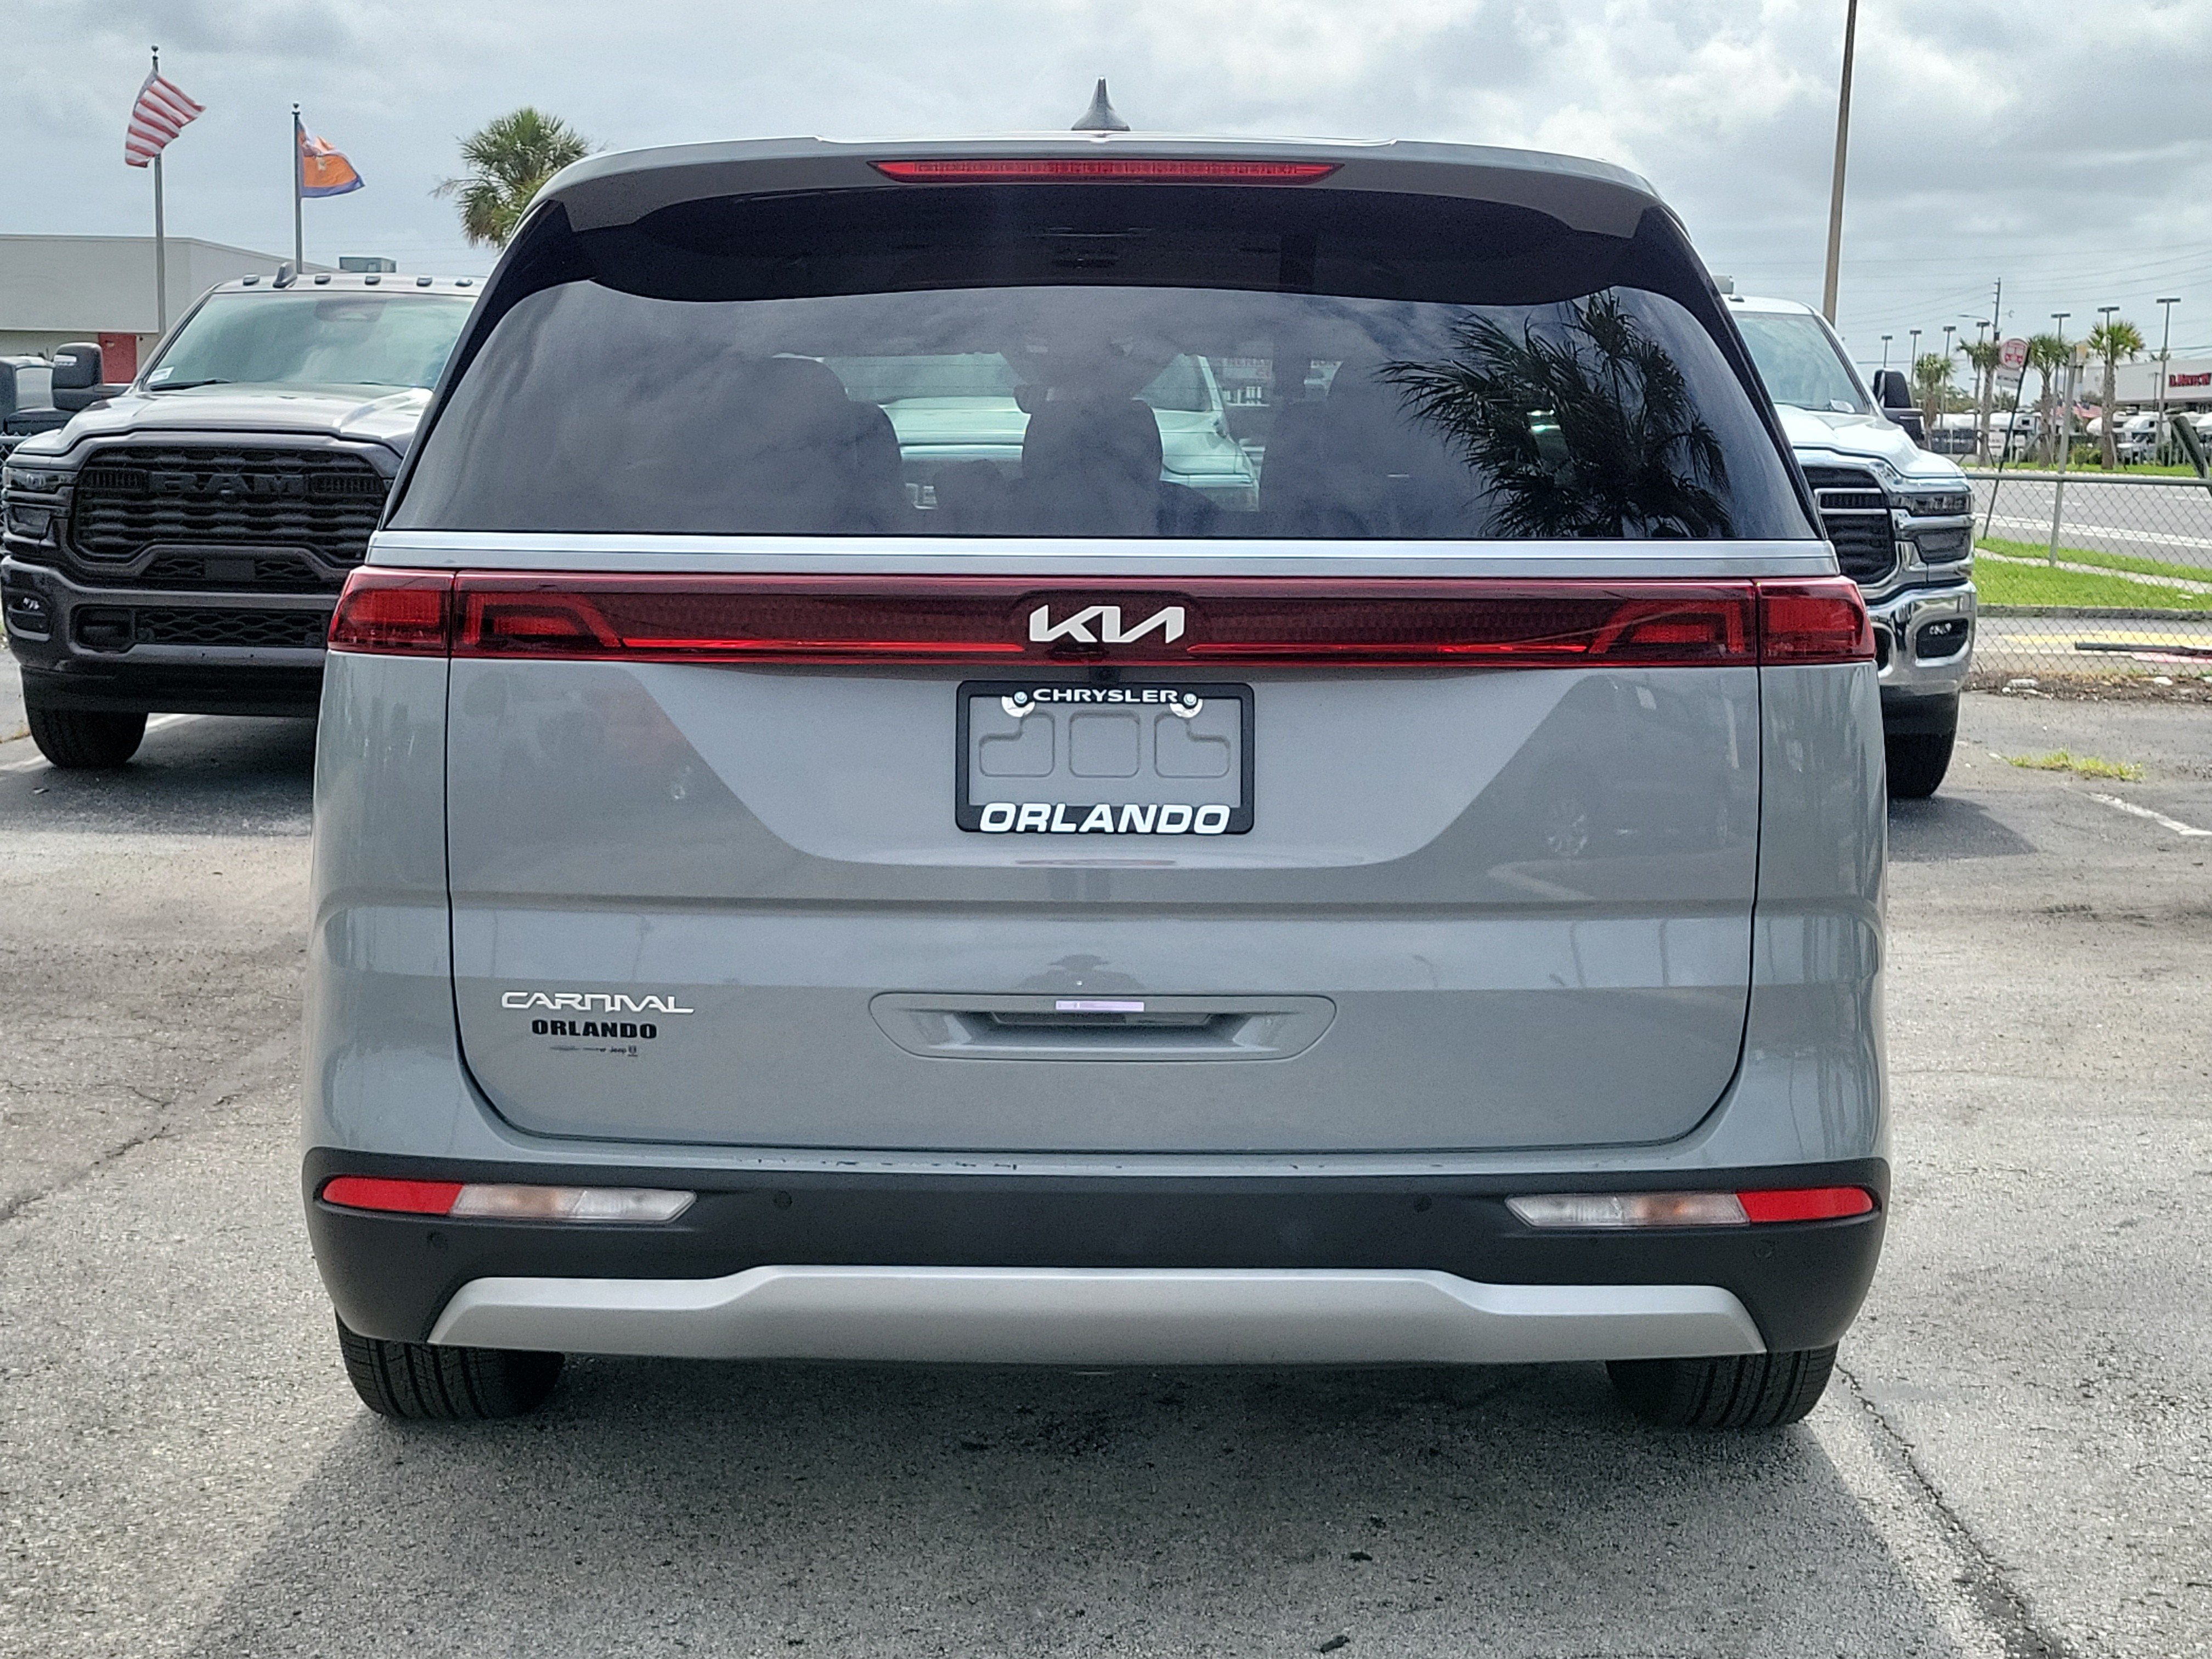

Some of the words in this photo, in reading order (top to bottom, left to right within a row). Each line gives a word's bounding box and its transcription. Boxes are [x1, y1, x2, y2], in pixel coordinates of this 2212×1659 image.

[1029, 604, 1186, 644] KIA
[1032, 687, 1178, 703] CHRYSLER
[979, 803, 1231, 835] ORLANDO
[501, 991, 695, 1014] CARNIVAL
[532, 1020, 657, 1039] ORLANDO
